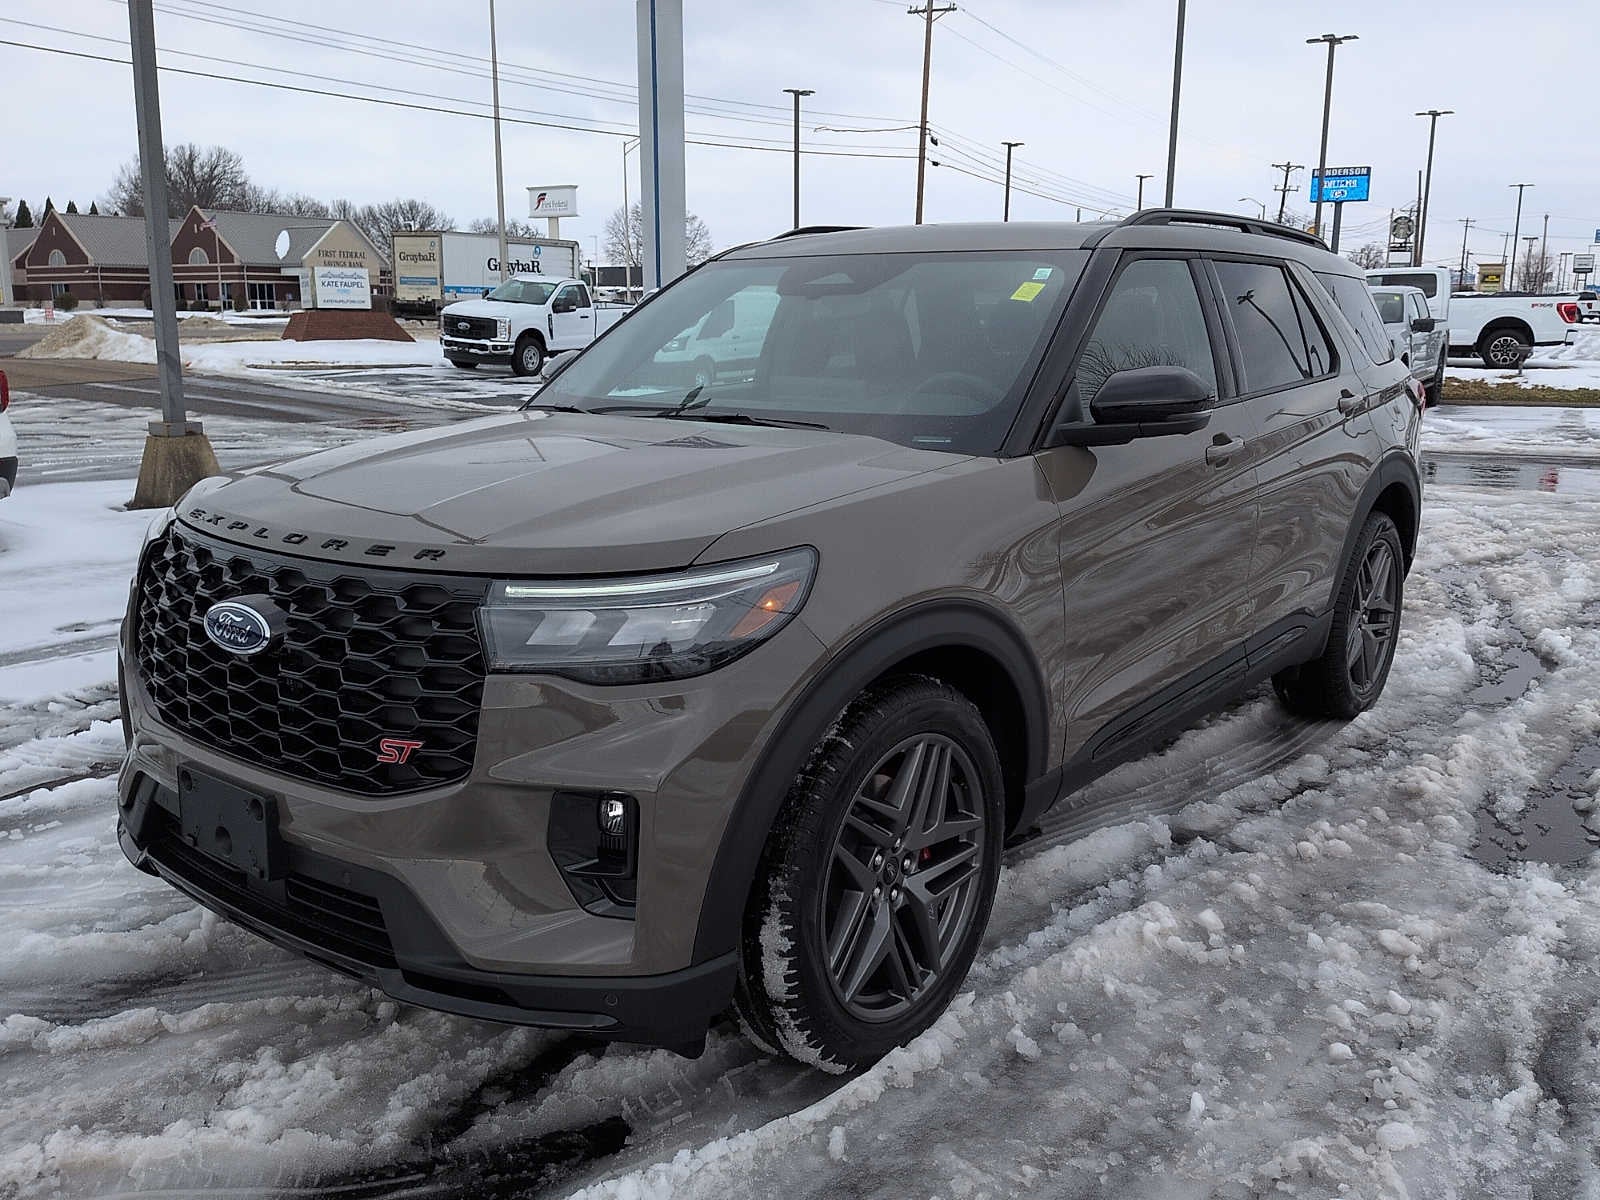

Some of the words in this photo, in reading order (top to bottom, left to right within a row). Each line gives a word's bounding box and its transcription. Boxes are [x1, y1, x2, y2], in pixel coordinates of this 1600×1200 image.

[1314, 168, 1368, 177] HNDERSON
[318, 249, 337, 259] FIRST
[339, 250, 367, 260] FEDERAL
[398, 251, 436, 264] GraybaR
[321, 280, 339, 288] KATE
[340, 280, 365, 289] FAUPEL
[189, 509, 446, 561] EXPLORER
[214, 611, 251, 644] Ford
[376, 738, 424, 765] ST
